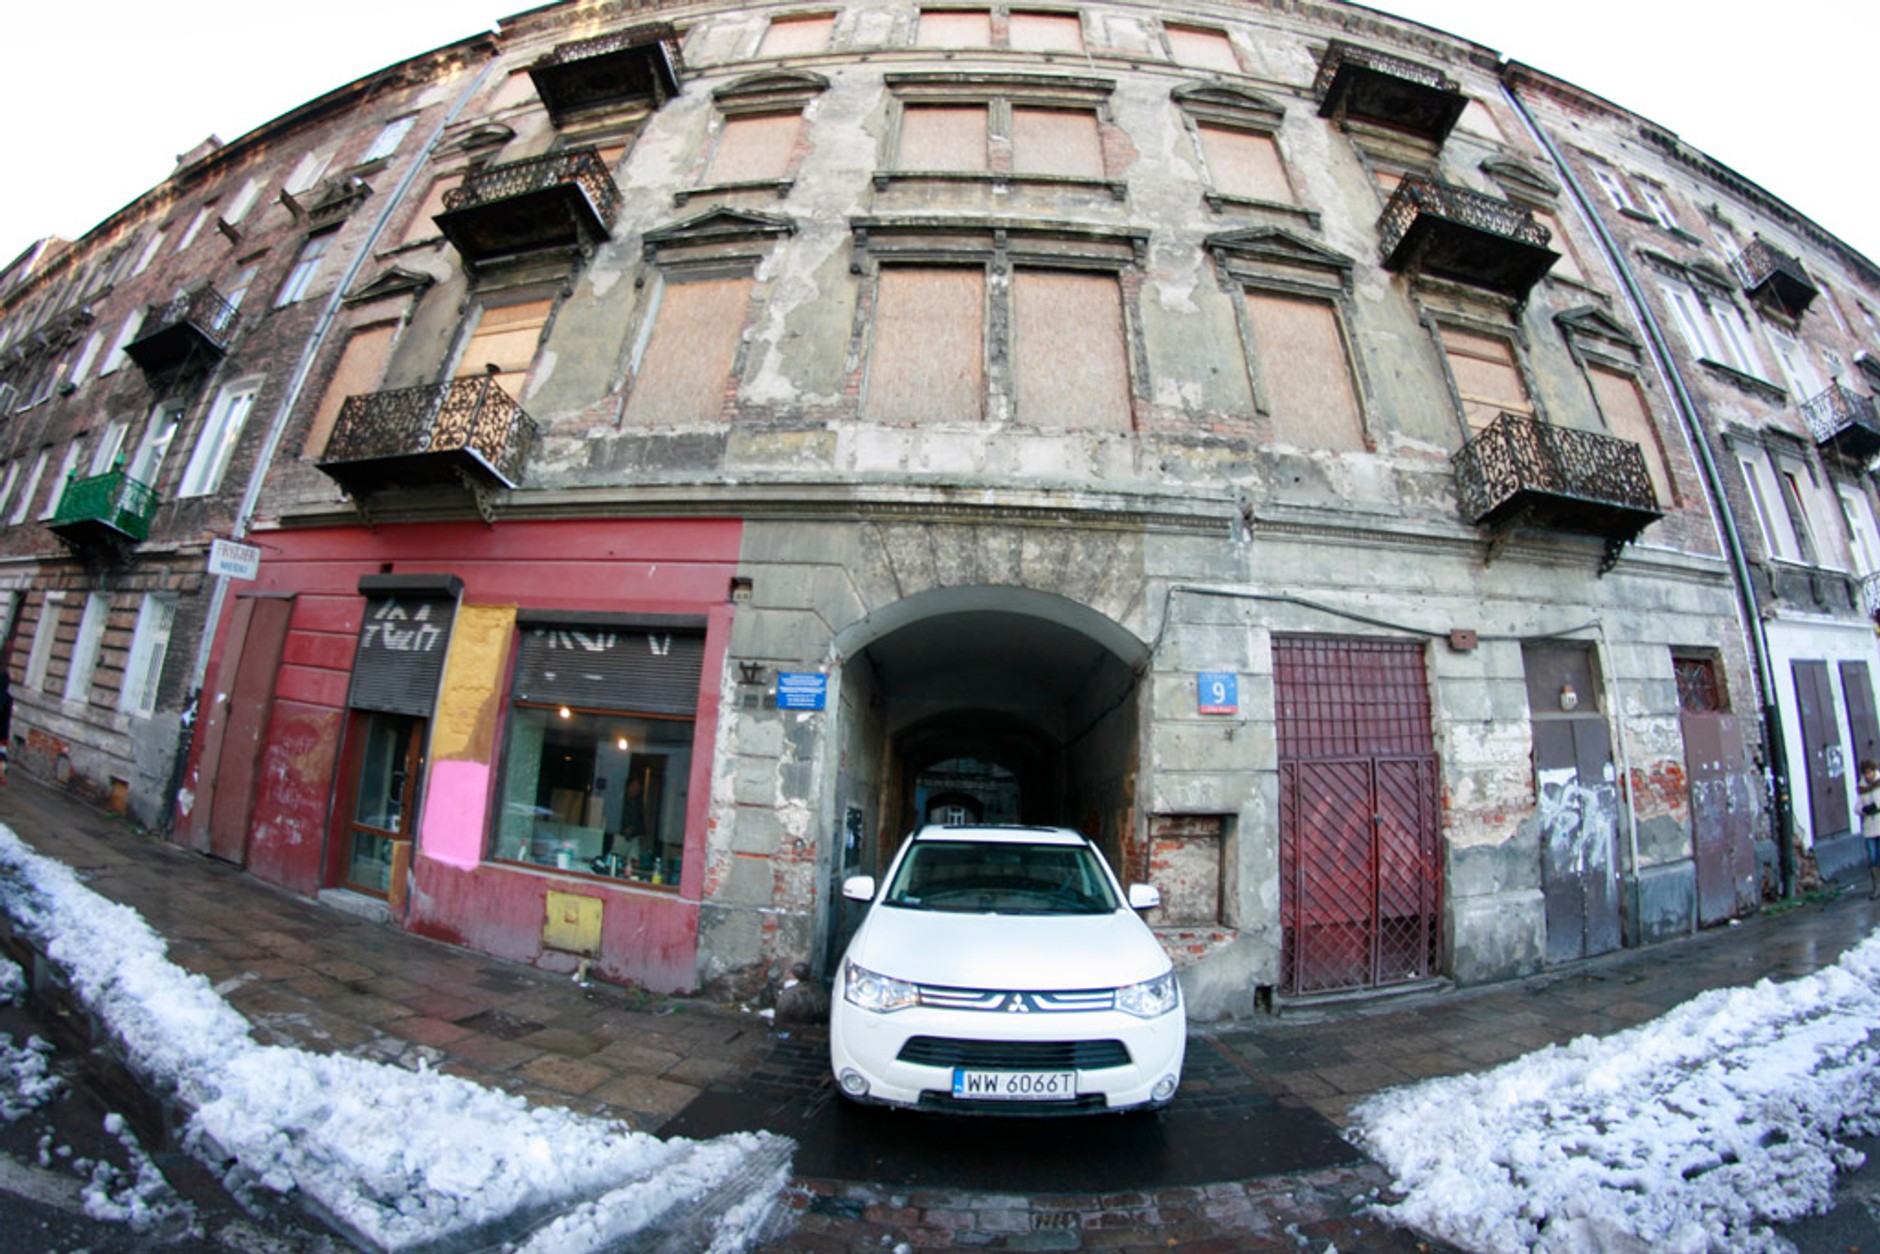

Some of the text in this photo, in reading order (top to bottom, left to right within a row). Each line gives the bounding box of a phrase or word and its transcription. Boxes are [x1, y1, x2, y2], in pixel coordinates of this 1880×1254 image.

[1212, 681, 1226, 704] 9
[967, 1073, 1072, 1093] WW 6066T
